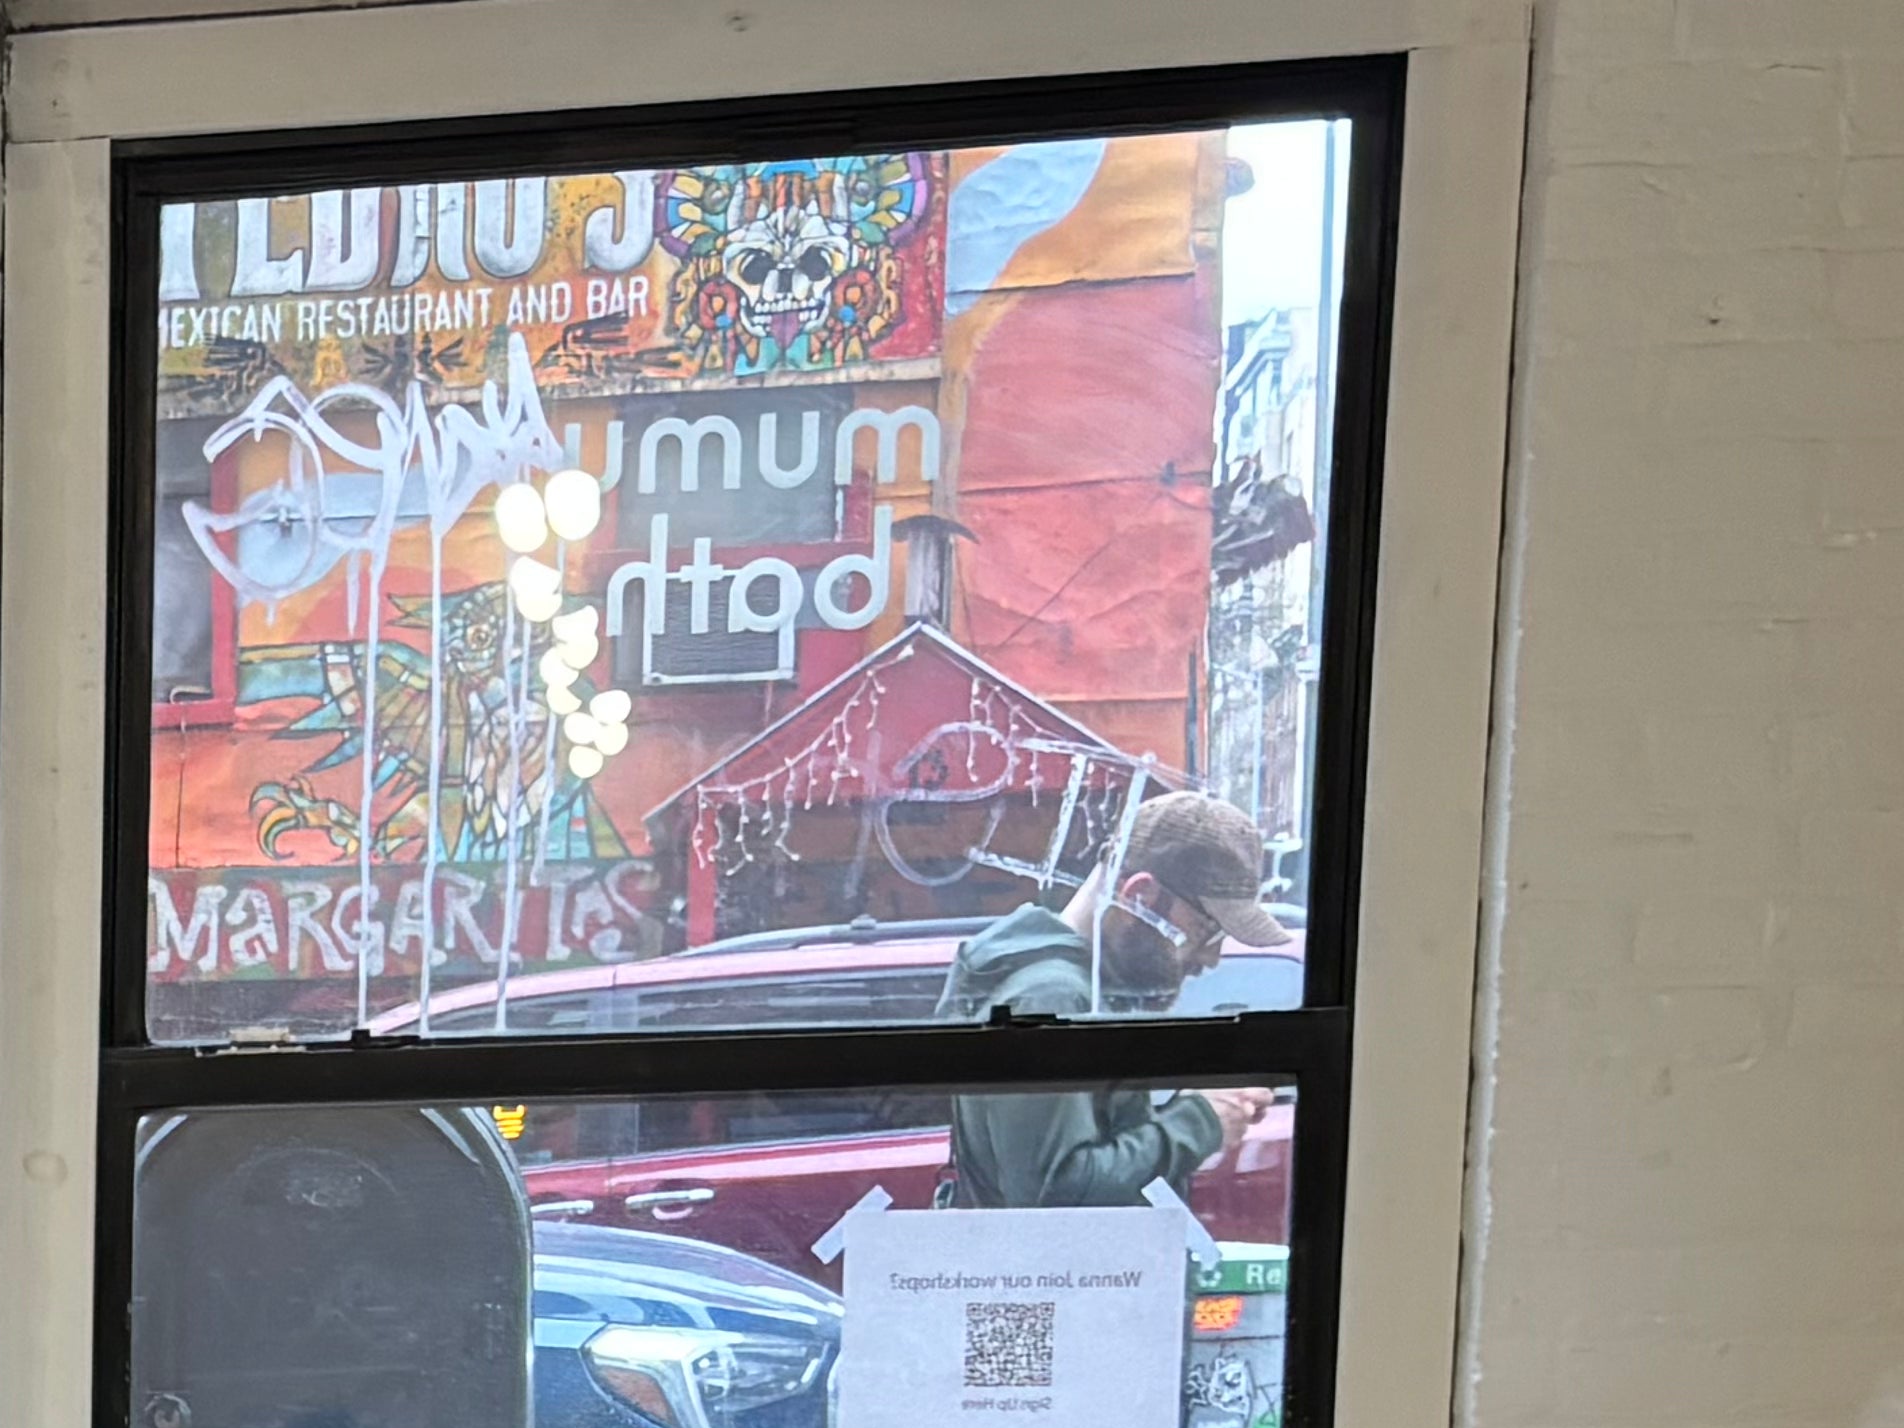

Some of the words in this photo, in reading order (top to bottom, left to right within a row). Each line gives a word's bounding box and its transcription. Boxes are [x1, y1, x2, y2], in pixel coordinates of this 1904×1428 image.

[298, 288, 493, 340] RESTAURANT
[507, 275, 572, 326] AND
[587, 276, 650, 319] BAR
